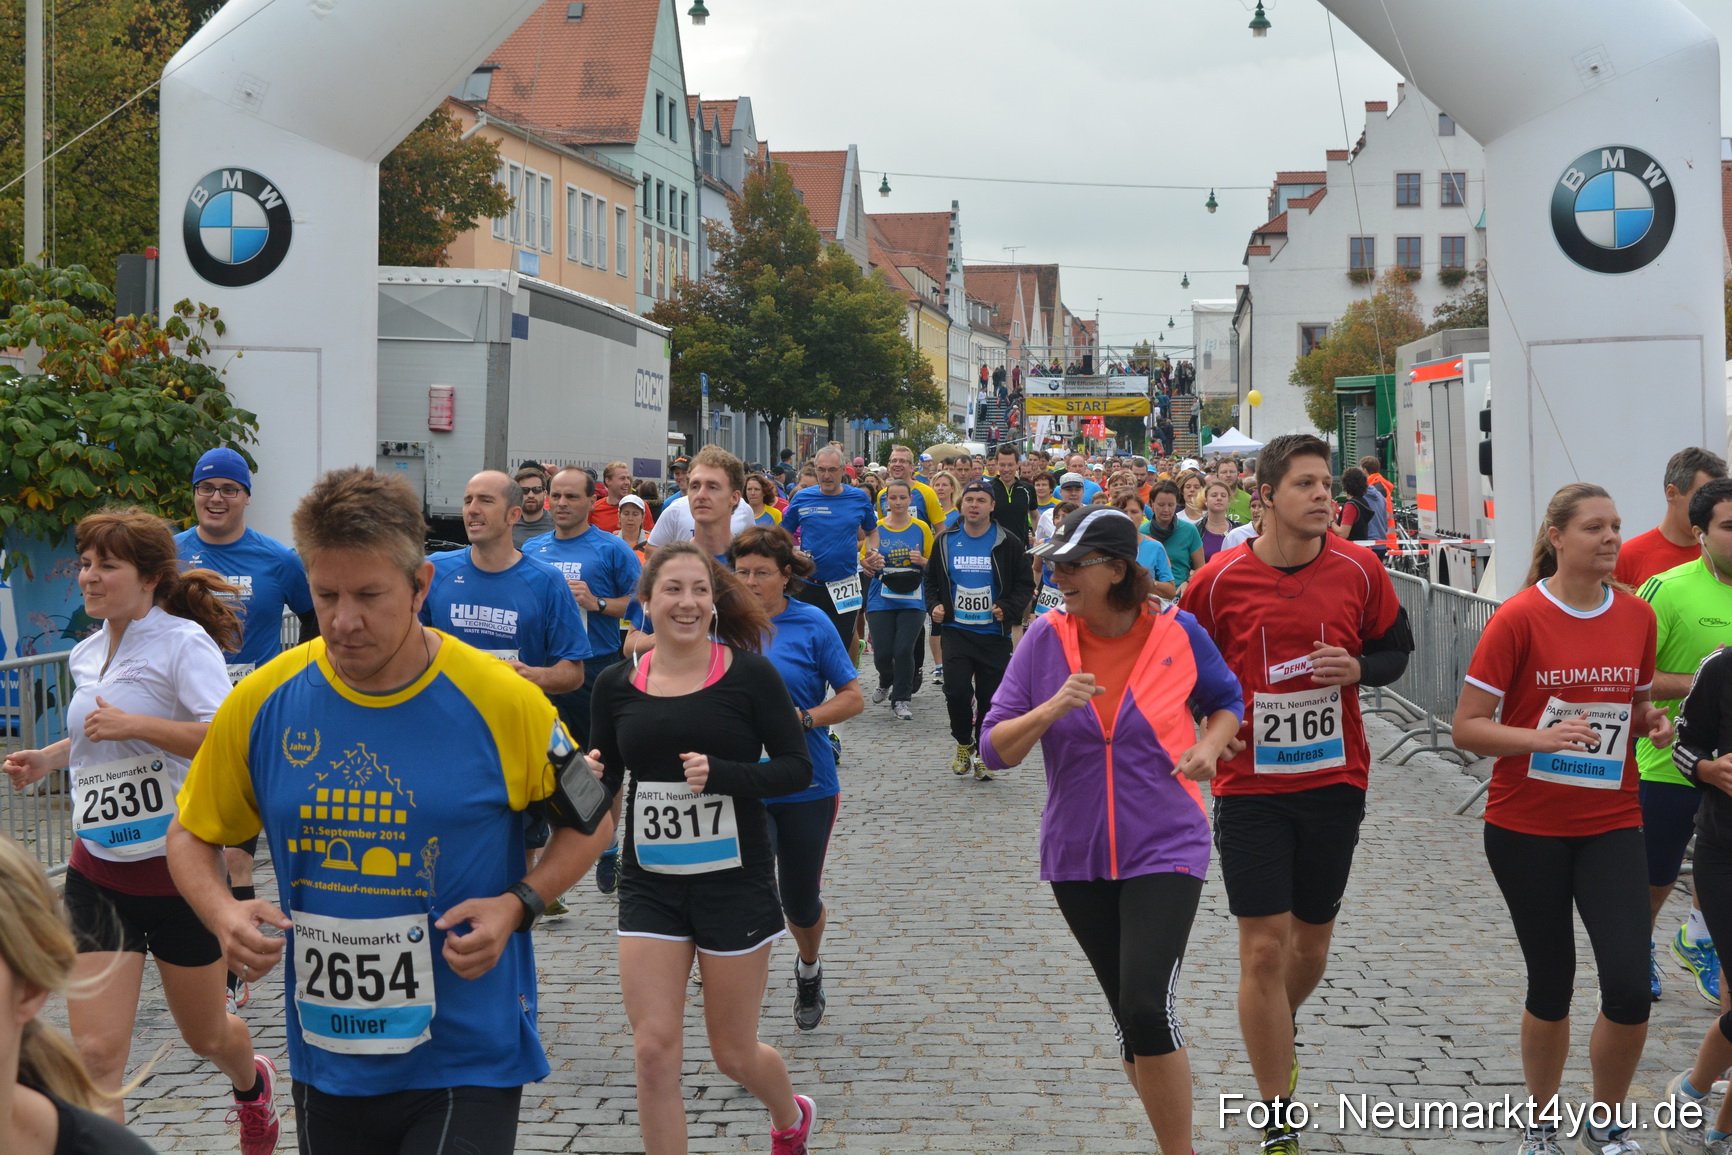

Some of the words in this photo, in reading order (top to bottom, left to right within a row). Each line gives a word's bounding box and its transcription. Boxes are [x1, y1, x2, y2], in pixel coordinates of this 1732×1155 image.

[1561, 149, 1667, 192] BMW
[190, 170, 284, 210] BMW
[635, 368, 664, 412] BOCK
[1066, 401, 1109, 411] START
[954, 556, 991, 565] HUBER
[957, 596, 989, 611] 2860
[450, 603, 518, 626] HUBER
[464, 620, 514, 632] TECHNOLOGY
[1284, 661, 1307, 675] DEHN
[1536, 667, 1632, 686] NEUMARKT
[1255, 701, 1286, 710] PARTL
[1288, 696, 1328, 709] Neumarkt
[1263, 707, 1335, 743] 2166
[297, 732, 307, 740] 15
[289, 743, 312, 752] Jahre
[1277, 748, 1324, 762] Andreas
[78, 772, 104, 787] PARTL
[106, 765, 148, 781] Neumarkt
[1551, 758, 1605, 776] Christina
[82, 777, 164, 825] 2530
[637, 792, 664, 800] PARTL
[643, 801, 723, 840] 3317
[108, 827, 141, 845] Julia
[303, 826, 377, 839] 21.September
[379, 830, 406, 840] 2014
[291, 878, 429, 897] www.stadtlauf-neumarkt.de
[295, 924, 329, 943] PARTL
[333, 932, 401, 945] Neumarkt
[305, 948, 419, 1002] 2654
[331, 1014, 387, 1034] Oliver
